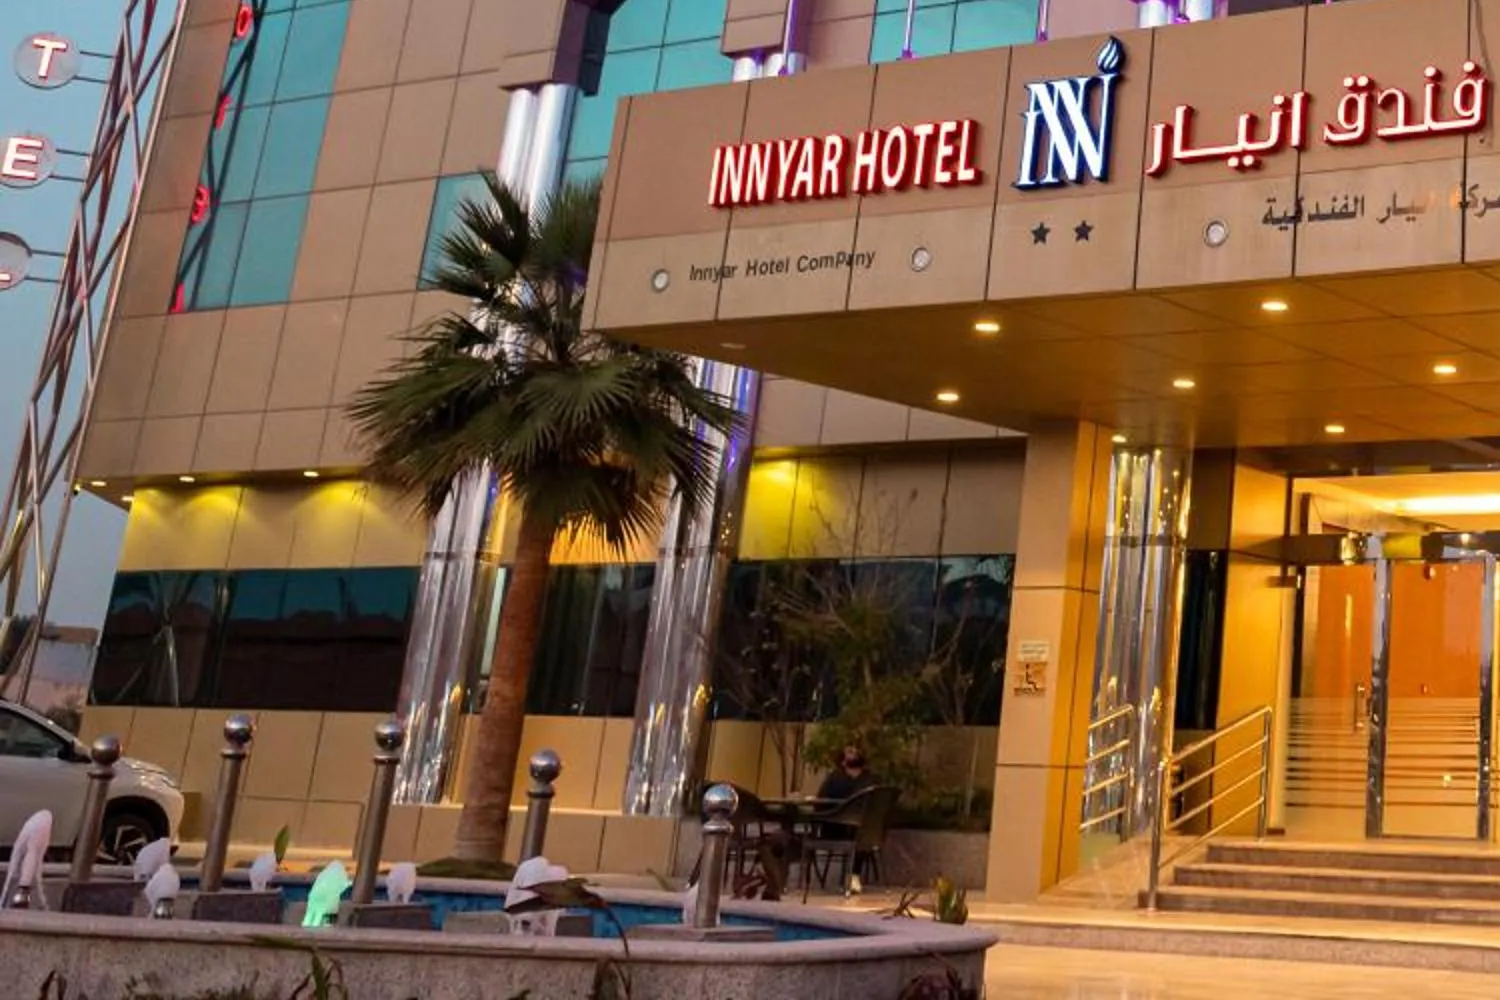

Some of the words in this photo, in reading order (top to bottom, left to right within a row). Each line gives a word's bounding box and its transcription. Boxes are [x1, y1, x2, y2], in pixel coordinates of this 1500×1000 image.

[1146, 90, 1311, 178] انيار
[1322, 60, 1490, 145] فندق
[707, 135, 849, 208] INNYAR
[851, 118, 983, 194] HOTEL
[689, 263, 738, 283] Innyar
[745, 256, 790, 277] Hotel
